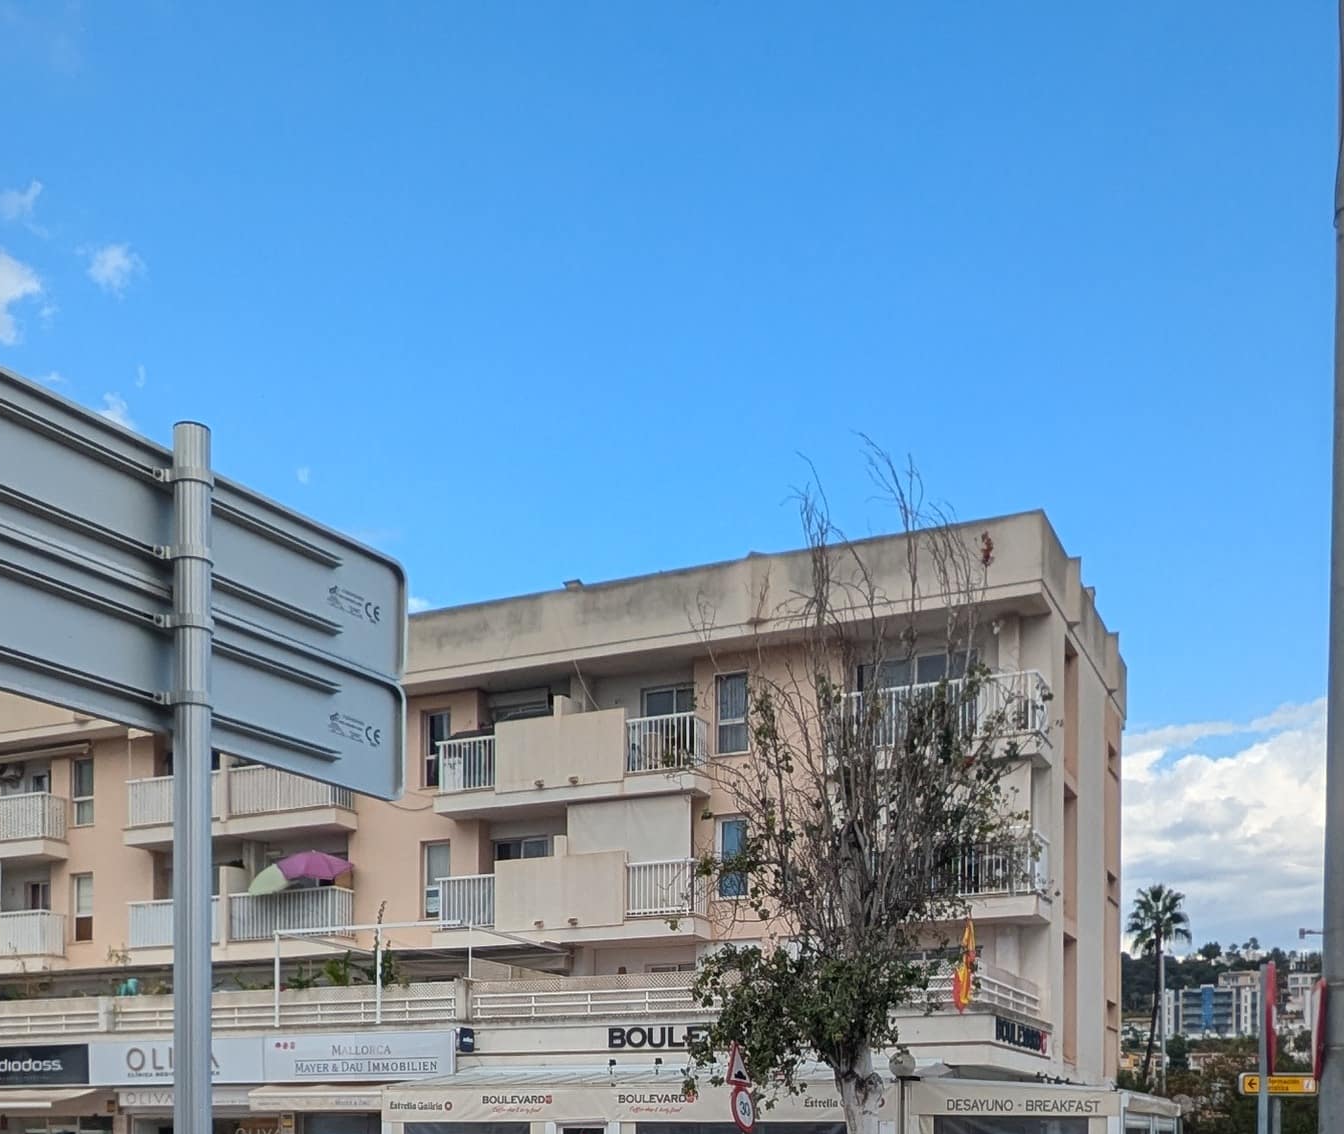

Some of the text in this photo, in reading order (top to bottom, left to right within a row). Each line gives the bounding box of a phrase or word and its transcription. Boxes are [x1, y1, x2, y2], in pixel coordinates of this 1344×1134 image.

[608, 1026, 705, 1049] BOULE
[331, 1044, 392, 1057] MALLORCA
[295, 1060, 438, 1073] MAYER & DAU IMMOBILIEN
[389, 1100, 443, 1111] Estrella Galicia
[482, 1095, 546, 1105] BOULEVARD
[618, 1094, 687, 1104] BOULEVARD
[804, 1098, 838, 1108] Estrella
[739, 1101, 751, 1117] 30
[946, 1099, 1014, 1112] DESAYUNO
[1025, 1100, 1101, 1113] BREAKFAST
